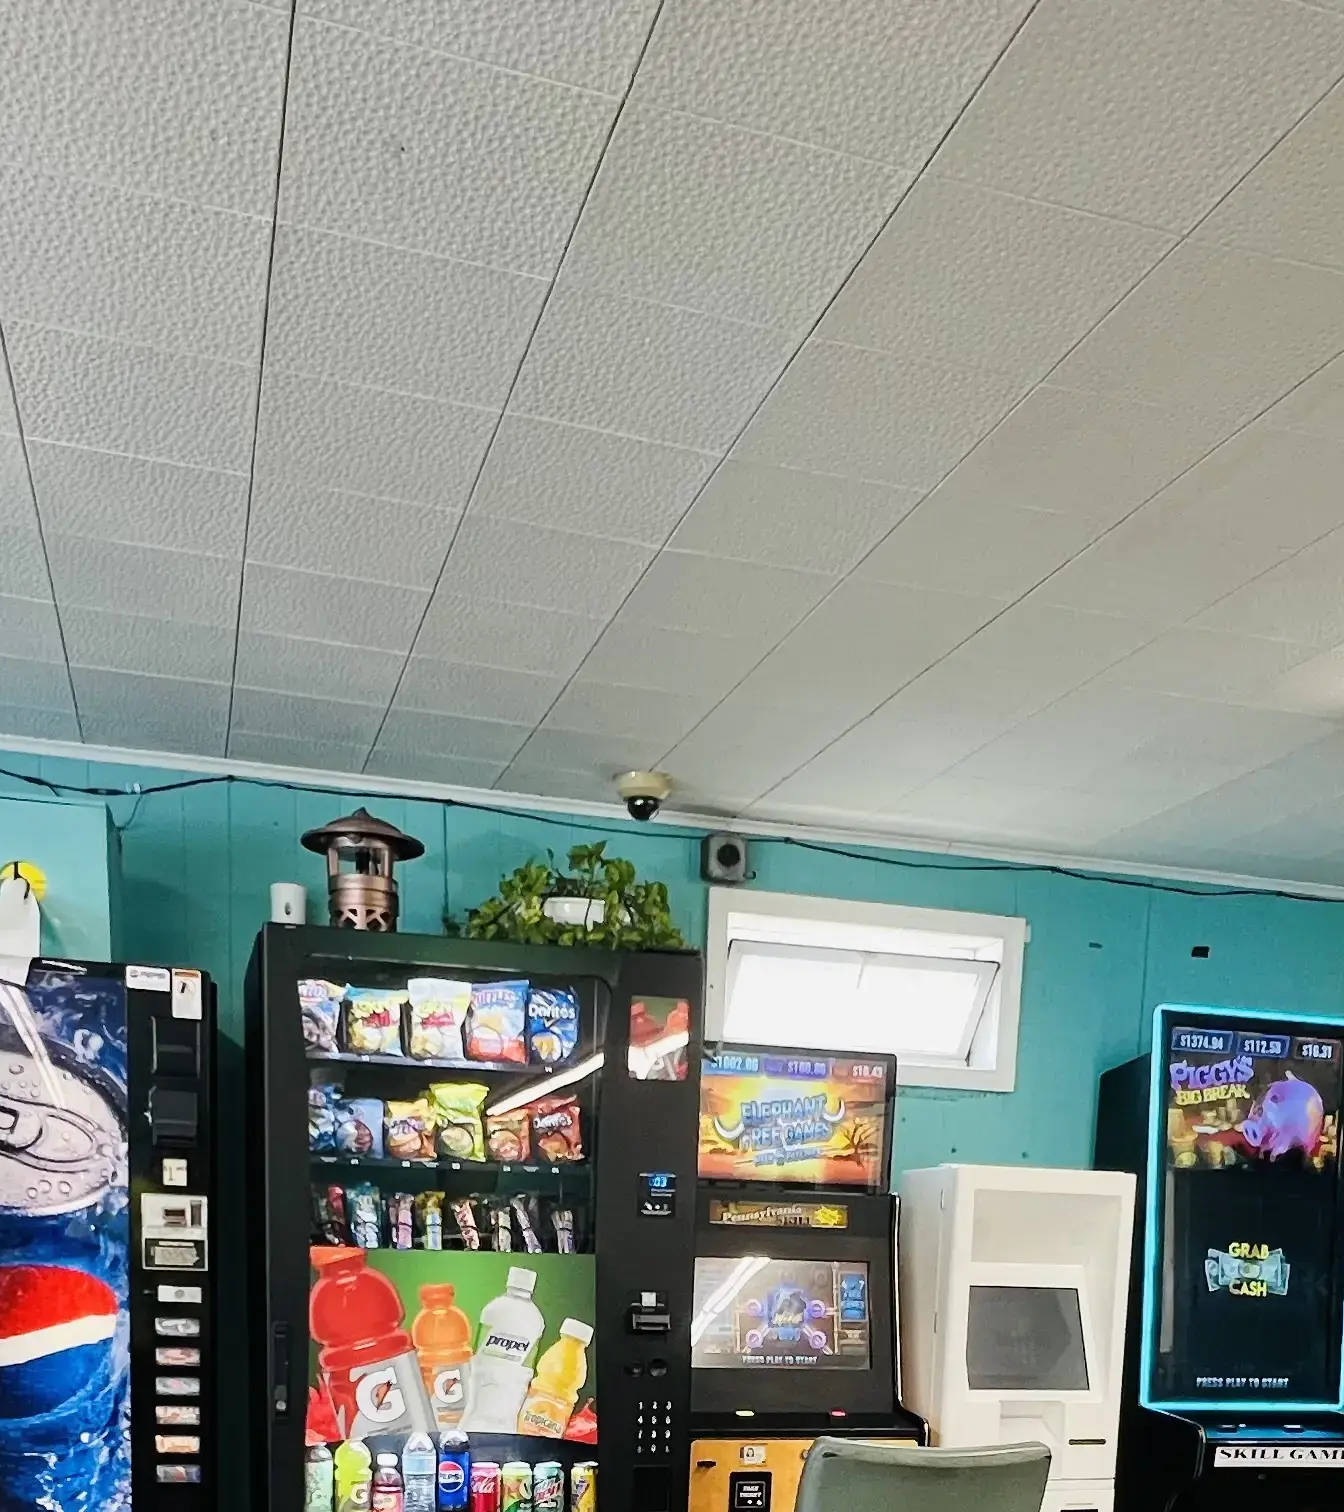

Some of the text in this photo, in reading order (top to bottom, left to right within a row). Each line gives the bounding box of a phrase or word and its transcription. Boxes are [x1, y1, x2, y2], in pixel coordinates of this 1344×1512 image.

[528, 1004, 576, 1019] Doritos
[1169, 1055, 1254, 1090] PIGGY'S
[1176, 1084, 1251, 1106] BIG BREAK
[741, 1093, 828, 1122] ELEPHANT
[722, 1206, 803, 1222] Pennsylvania
[1228, 1242, 1270, 1260] GRAB
[1228, 1279, 1268, 1298] CASH
[485, 1332, 530, 1353] propel
[433, 1369, 464, 1403] G
[1196, 1377, 1224, 1388] PRESS
[1248, 1377, 1259, 1388] TO
[1261, 1377, 1289, 1389] START
[349, 1365, 407, 1423] G
[1219, 1448, 1284, 1460] SKILL
